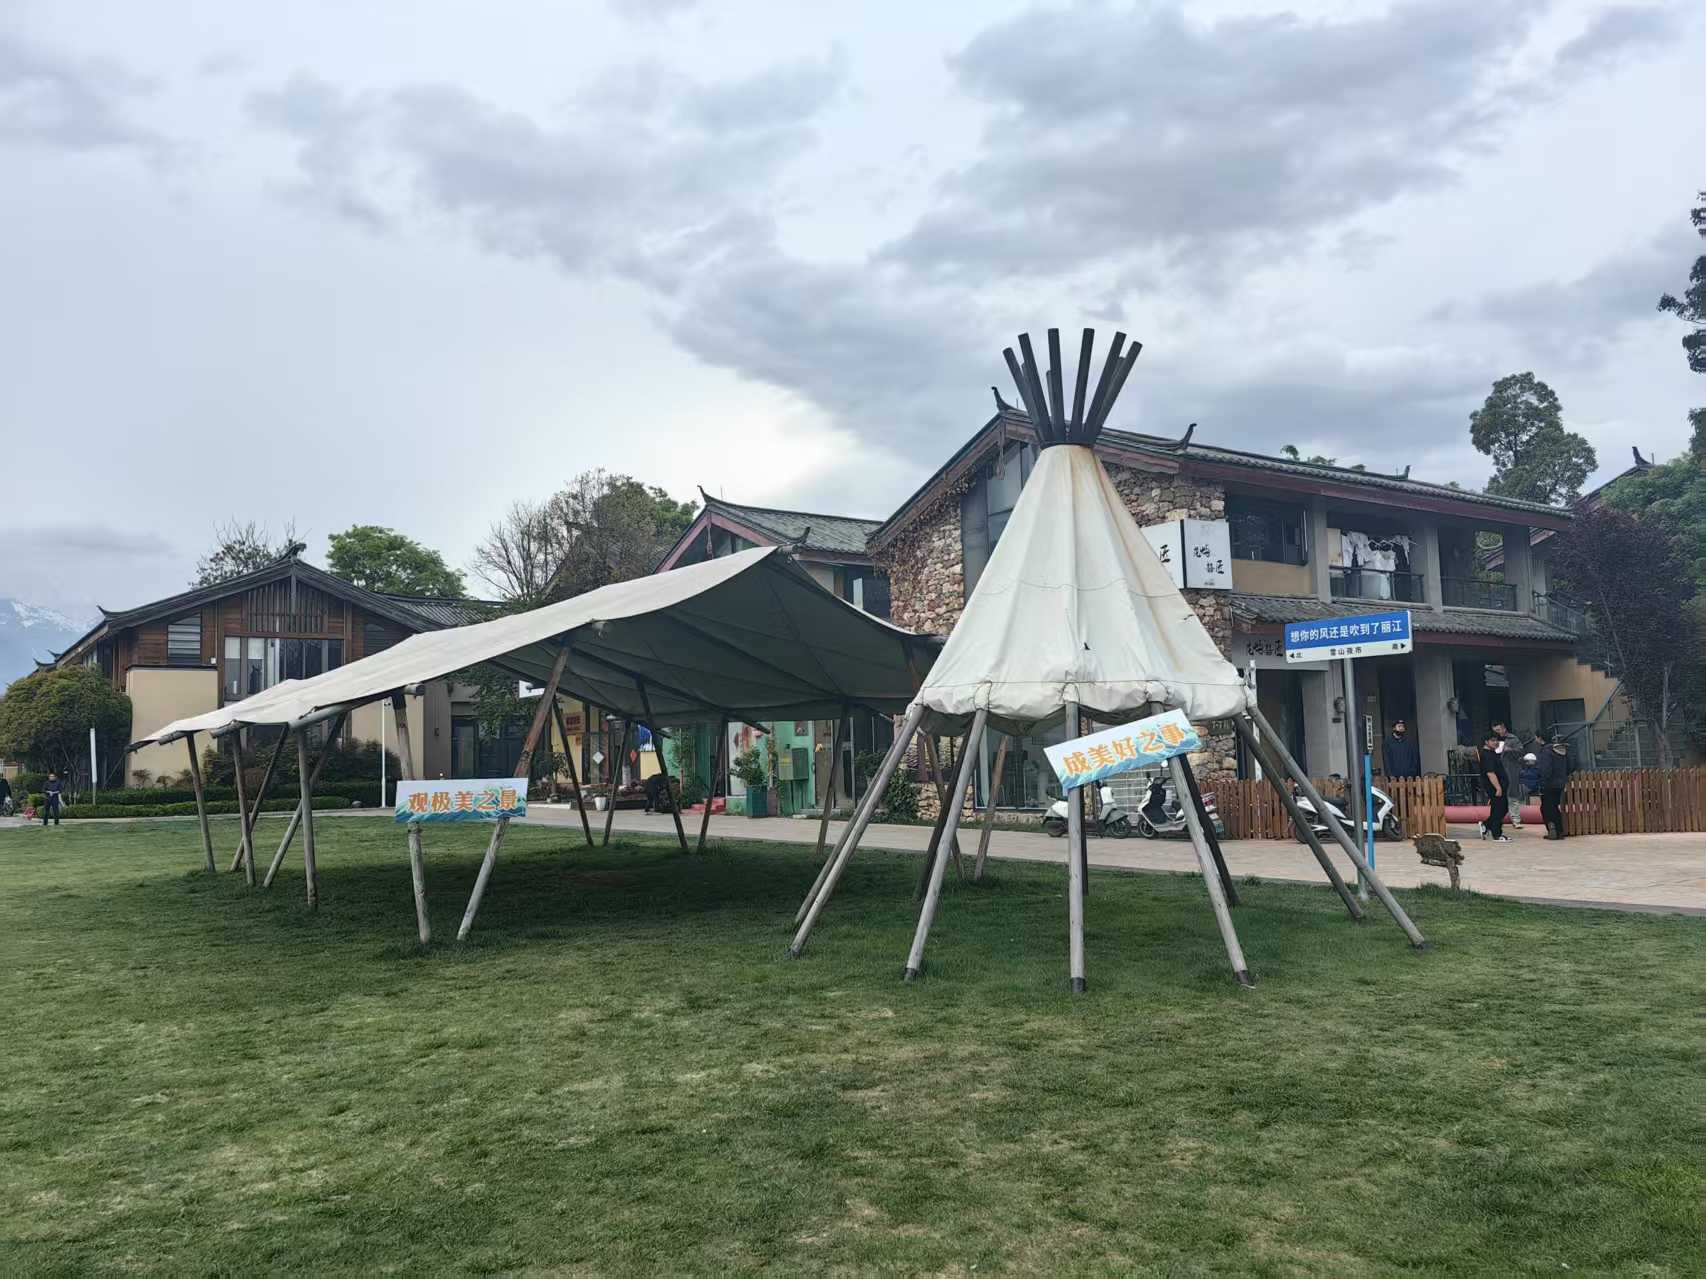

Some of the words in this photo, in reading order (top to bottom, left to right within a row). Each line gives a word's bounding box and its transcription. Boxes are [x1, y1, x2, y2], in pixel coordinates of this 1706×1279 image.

[1290, 620, 1402, 643] 想你的风还是吹到了丽江
[1330, 646, 1362, 656] 雪山夜市
[1062, 722, 1186, 776] 成美好之事
[408, 786, 518, 813] 观极美之景
